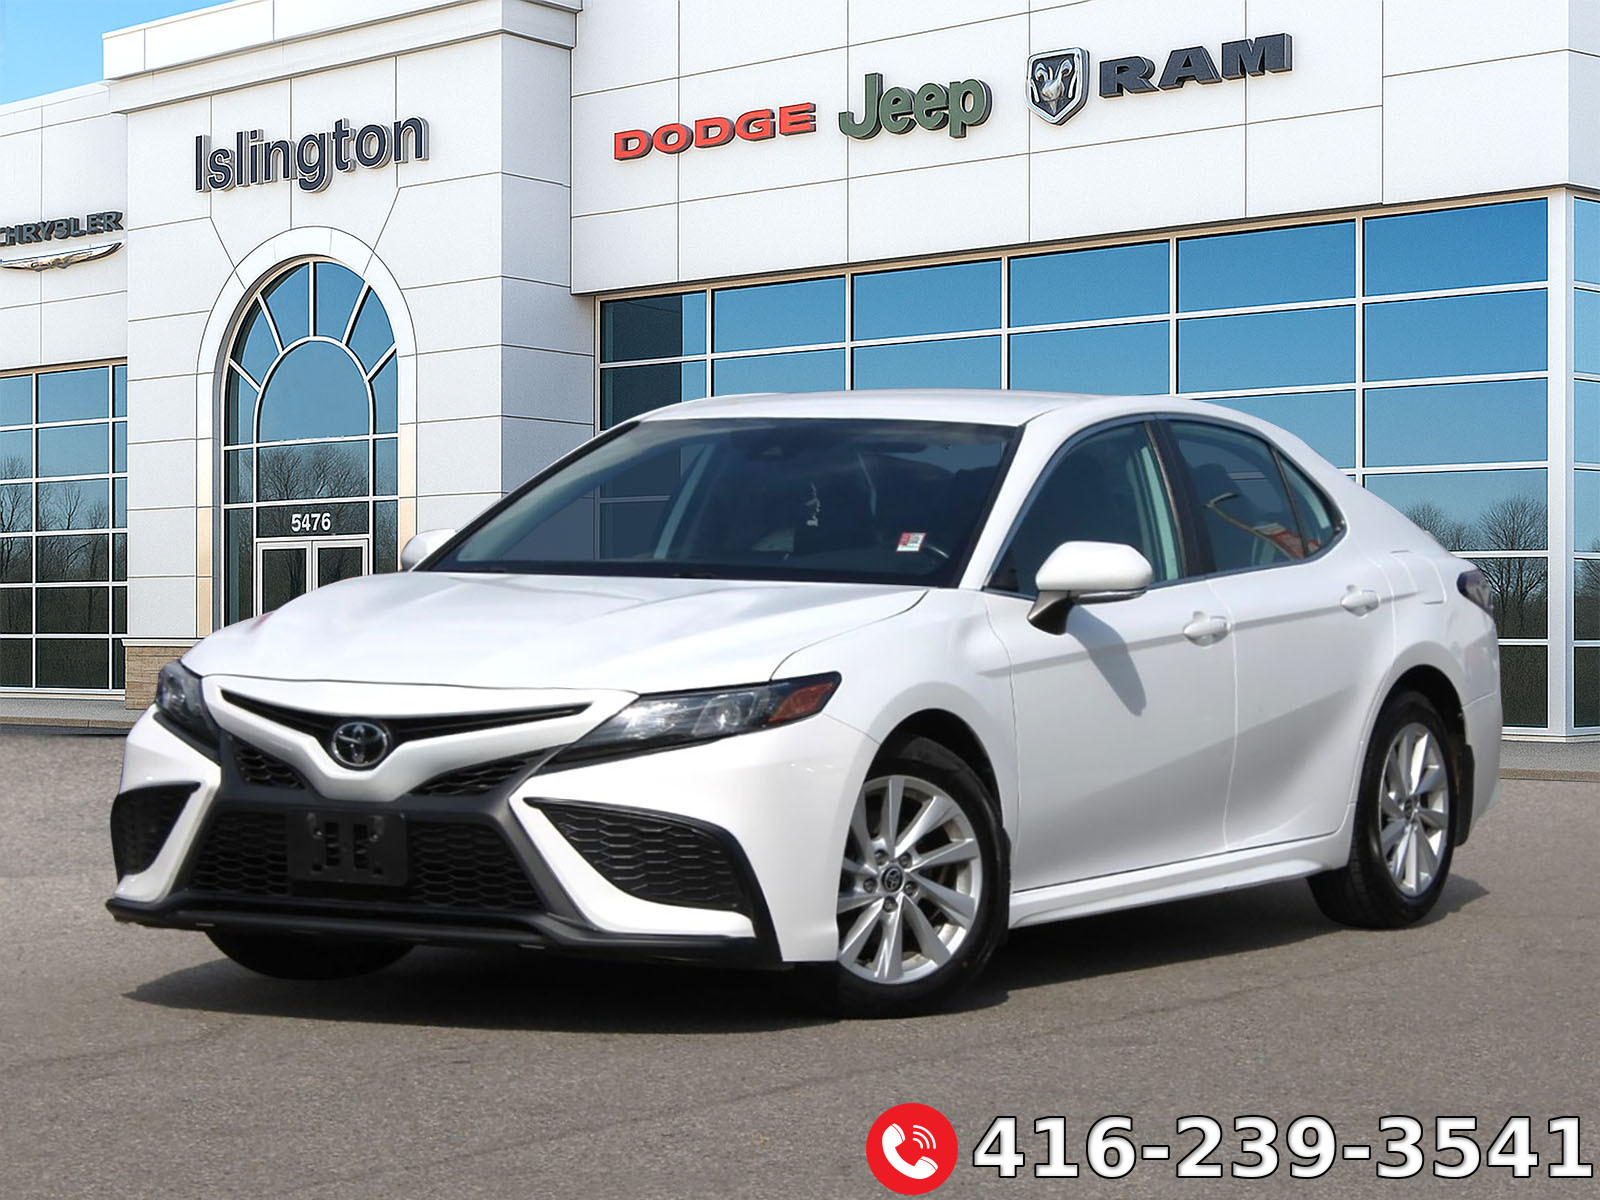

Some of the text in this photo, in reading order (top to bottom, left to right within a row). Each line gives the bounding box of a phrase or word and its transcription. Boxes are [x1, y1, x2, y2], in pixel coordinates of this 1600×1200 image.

[1099, 33, 1293, 98] RAM
[613, 102, 817, 161] DODGE
[838, 73, 992, 140] Jeep
[195, 115, 429, 192] Islington
[291, 512, 331, 532] 5476
